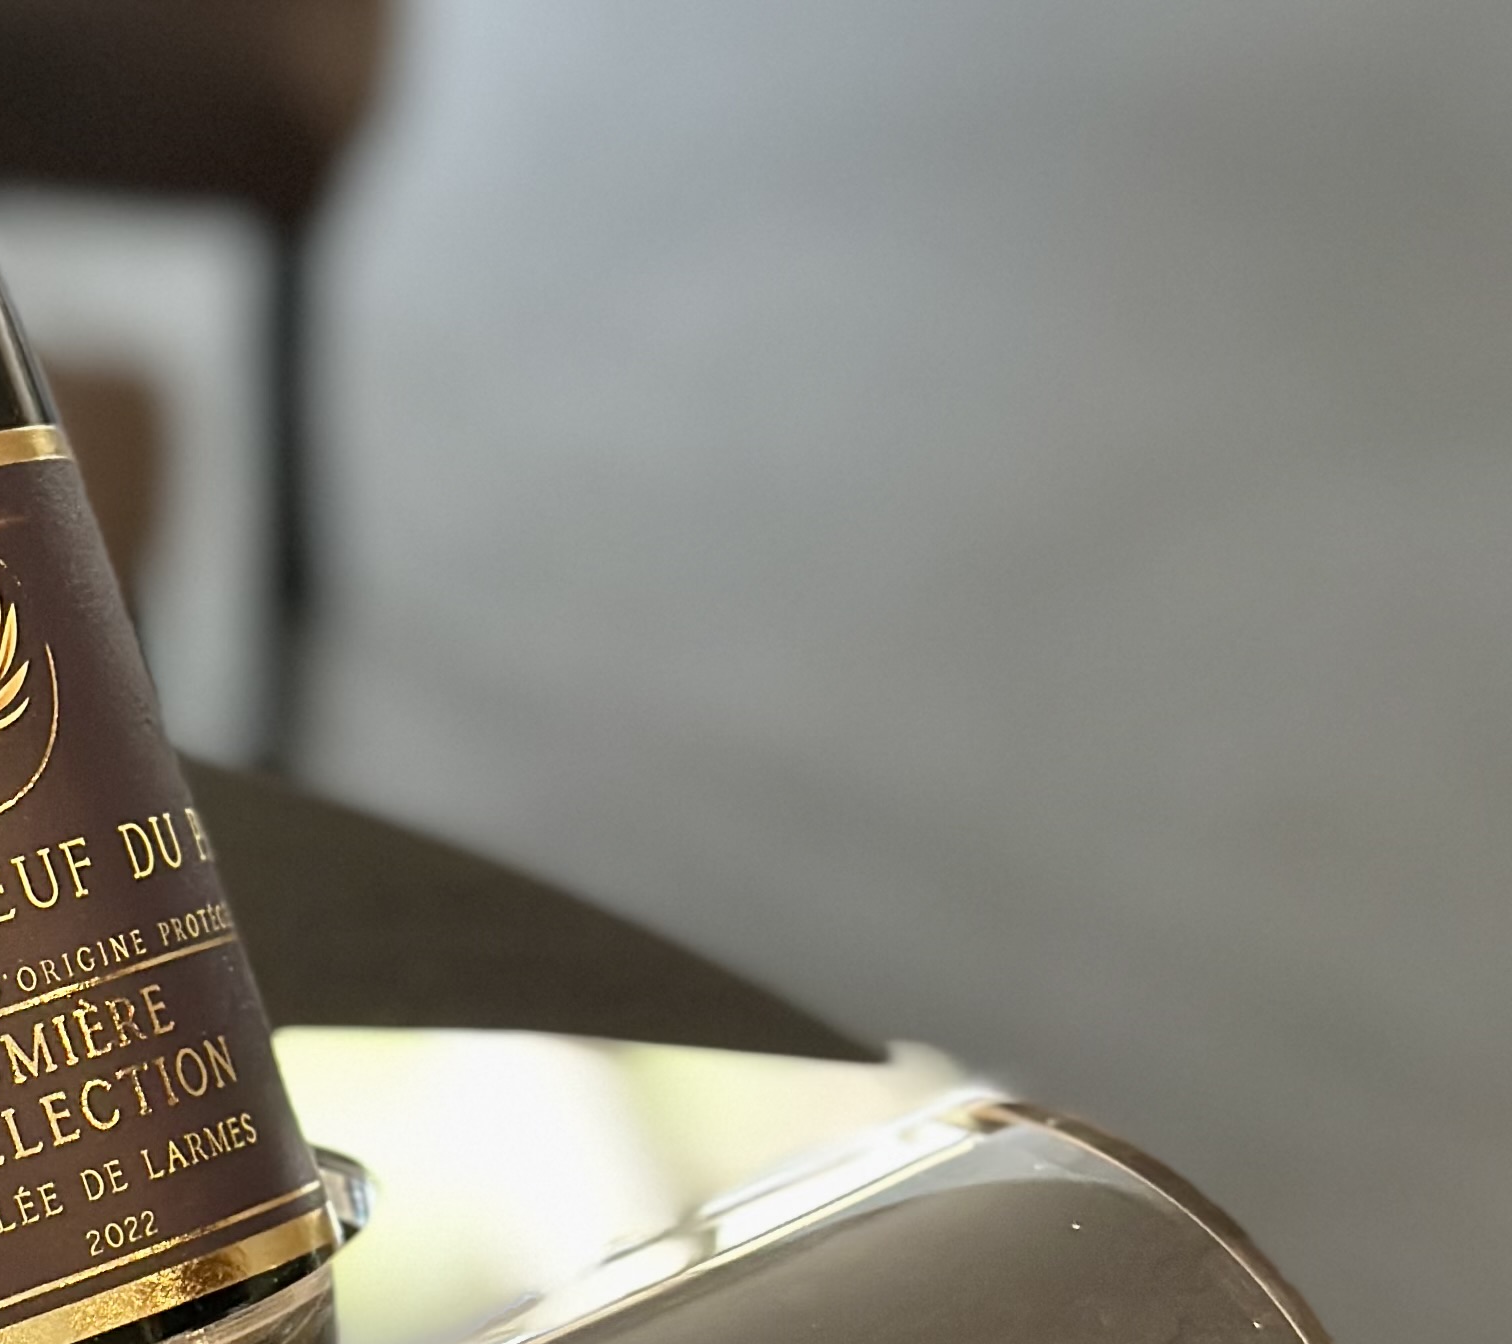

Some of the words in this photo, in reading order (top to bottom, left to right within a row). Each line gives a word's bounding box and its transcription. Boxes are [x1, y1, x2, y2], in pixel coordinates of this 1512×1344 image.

[118, 812, 183, 880] DU
[80, 1160, 129, 1202] DE
[141, 1112, 259, 1180] LARMES
[86, 1210, 159, 1258] 2022
